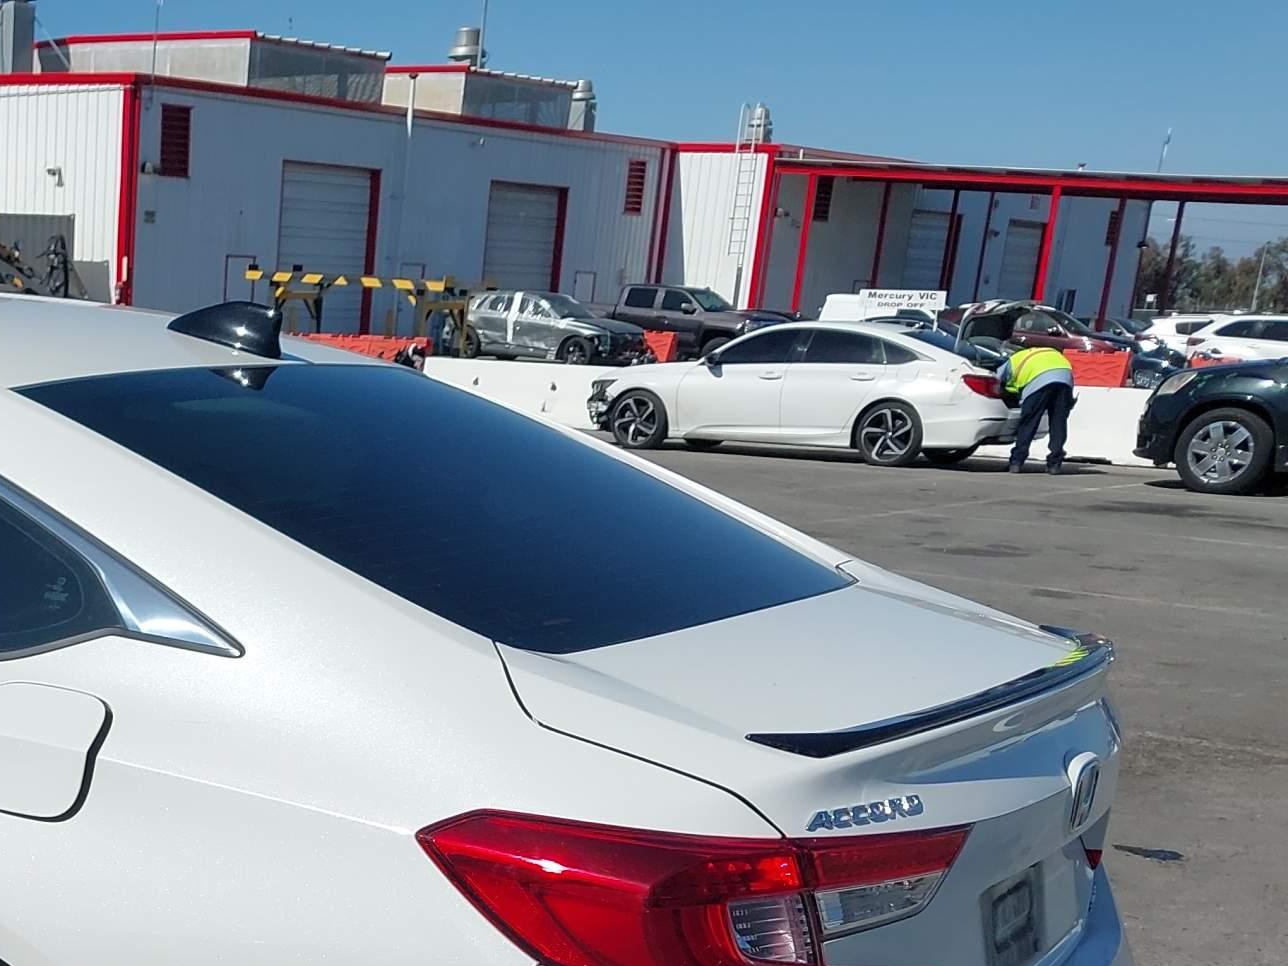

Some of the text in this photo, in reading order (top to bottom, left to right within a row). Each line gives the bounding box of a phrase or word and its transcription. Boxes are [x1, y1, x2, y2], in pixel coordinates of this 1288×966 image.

[868, 291, 937, 300] Mercury VIC
[805, 794, 924, 832] ACCORD
